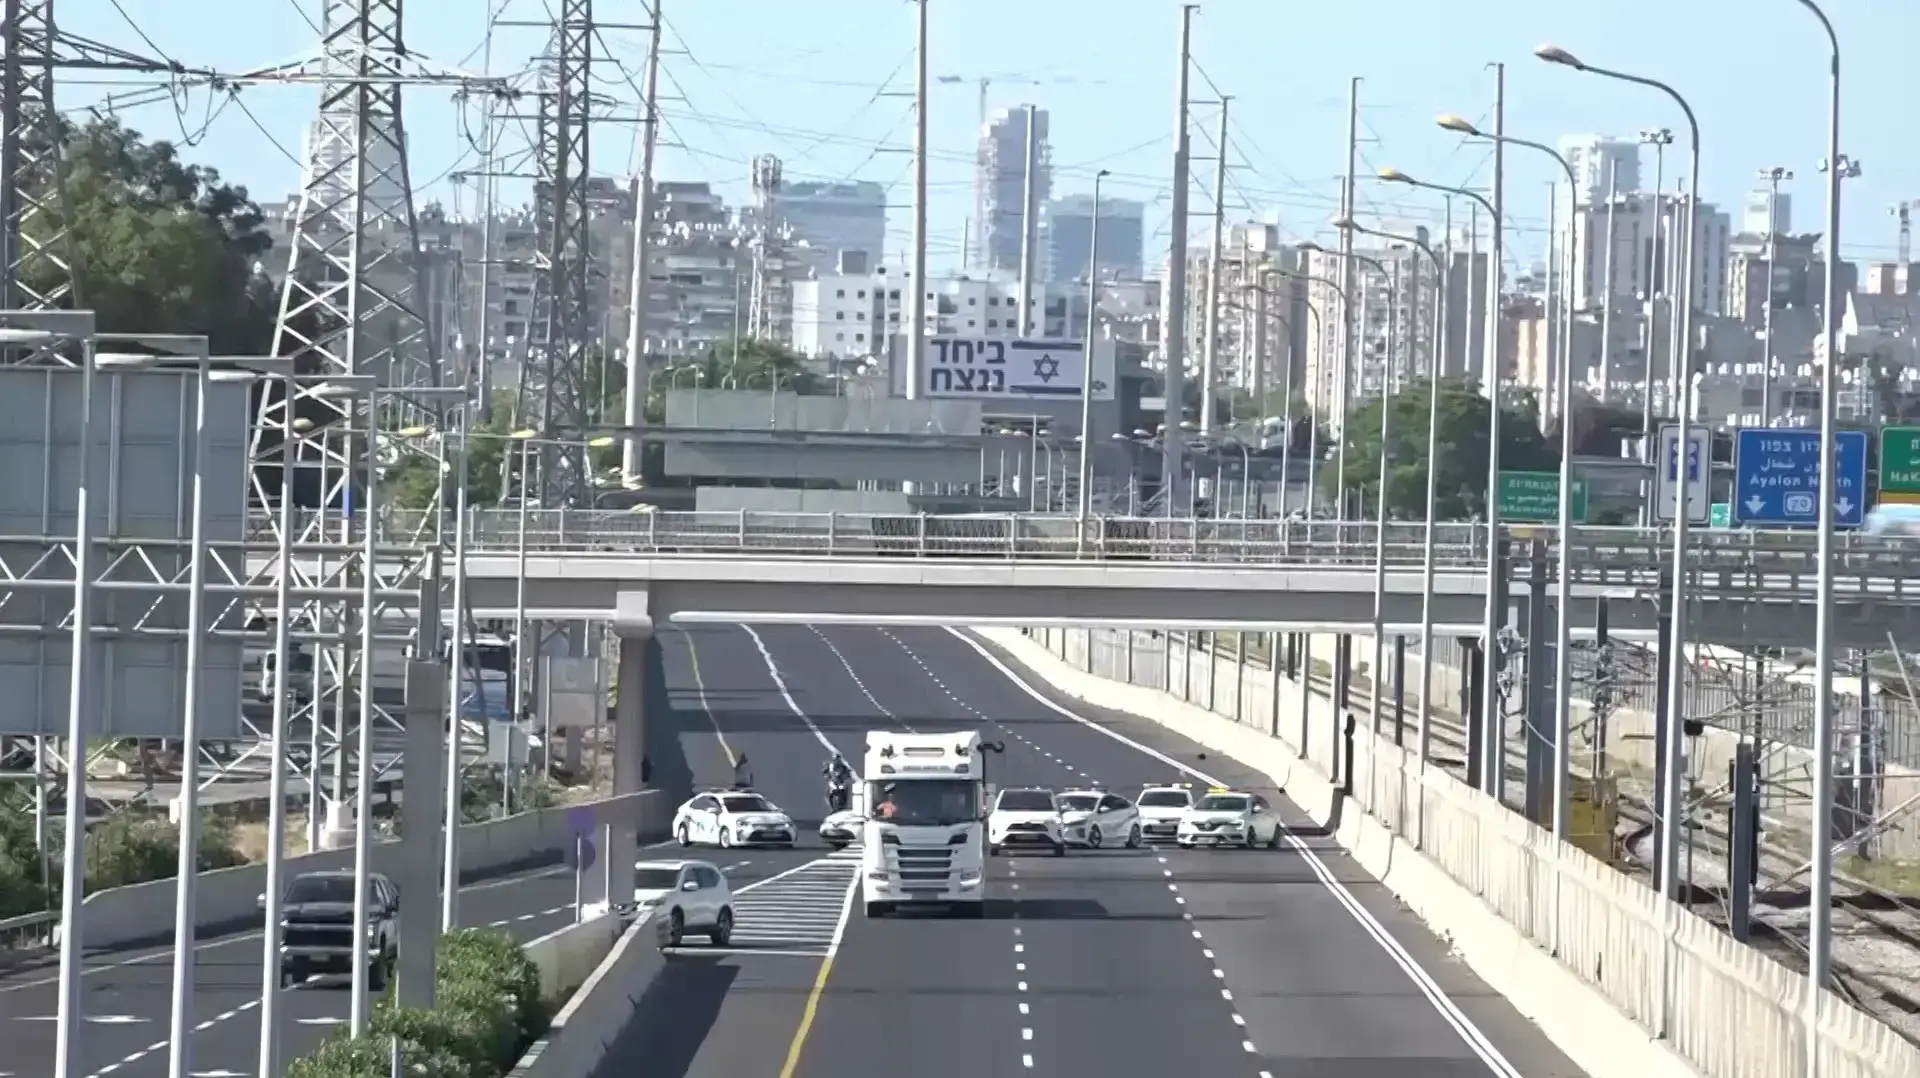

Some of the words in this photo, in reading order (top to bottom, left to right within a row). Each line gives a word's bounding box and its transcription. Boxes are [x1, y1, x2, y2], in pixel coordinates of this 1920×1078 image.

[930, 339, 1006, 364] ביחד
[930, 367, 1005, 392] ננצח
[1760, 439, 1792, 452] צפון
[1749, 472, 1801, 488] Ayalon
[1807, 475, 1852, 488] Nth
